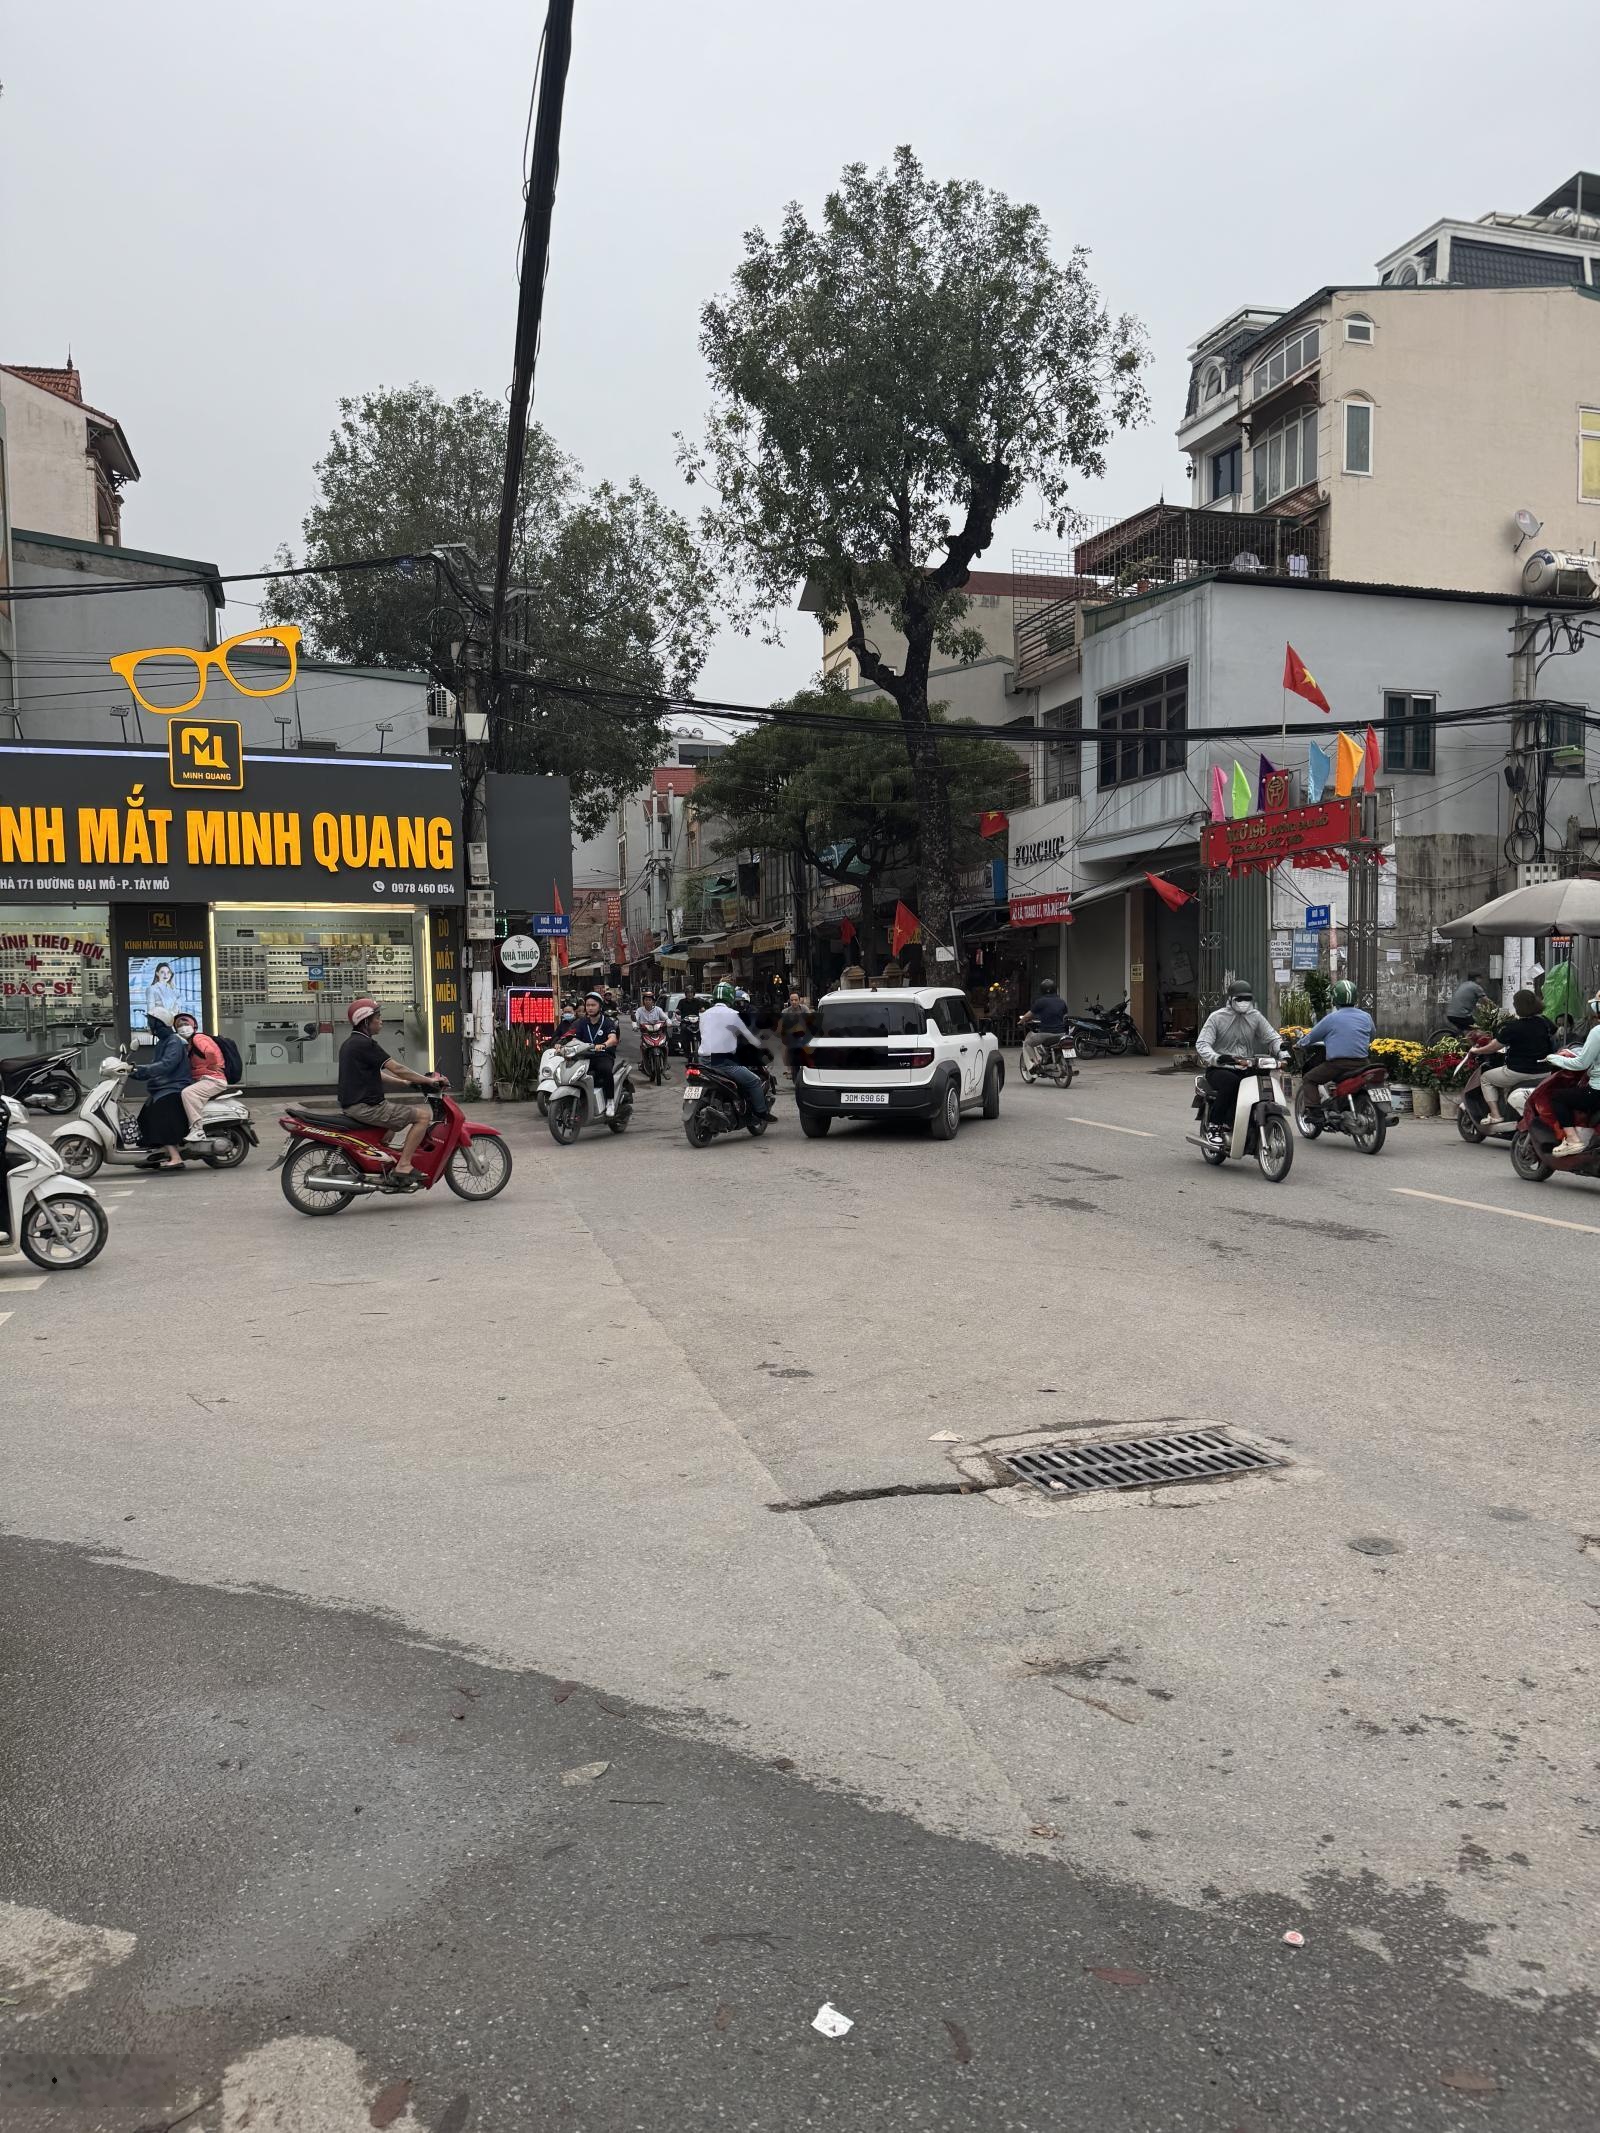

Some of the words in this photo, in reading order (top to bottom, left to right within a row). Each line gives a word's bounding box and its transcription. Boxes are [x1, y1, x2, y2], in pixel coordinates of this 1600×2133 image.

[182, 771, 204, 780] MINH
[205, 772, 232, 781] QUANG
[0, 806, 66, 863] NH
[78, 783, 173, 864] MẮT
[186, 810, 302, 866] MINH
[312, 812, 454, 873] QUANG
[1015, 836, 1065, 867] FORCHIC
[16, 878, 33, 890] 171
[37, 876, 75, 890] ĐƯỜNG
[78, 878, 97, 891] ĐẠI
[134, 877, 153, 890] TÂY
[153, 876, 170, 890] MỖ
[391, 882, 416, 894] 0978
[418, 883, 436, 894] 460
[437, 883, 455, 894] 054
[0, 932, 28, 951] ÍNH
[32, 933, 70, 951] THEO
[158, 940, 178, 950] MINH
[179, 940, 204, 950] QUANG
[436, 944, 455, 969] MẮT
[502, 949, 517, 961] NHÀ
[517, 947, 539, 961] THUỐC
[3, 978, 46, 995] BÁC
[53, 977, 77, 995] SĨ
[435, 977, 457, 1002] MIỄN
[511, 991, 555, 1023] KÍNH
[440, 1011, 455, 1034] PHÍ
